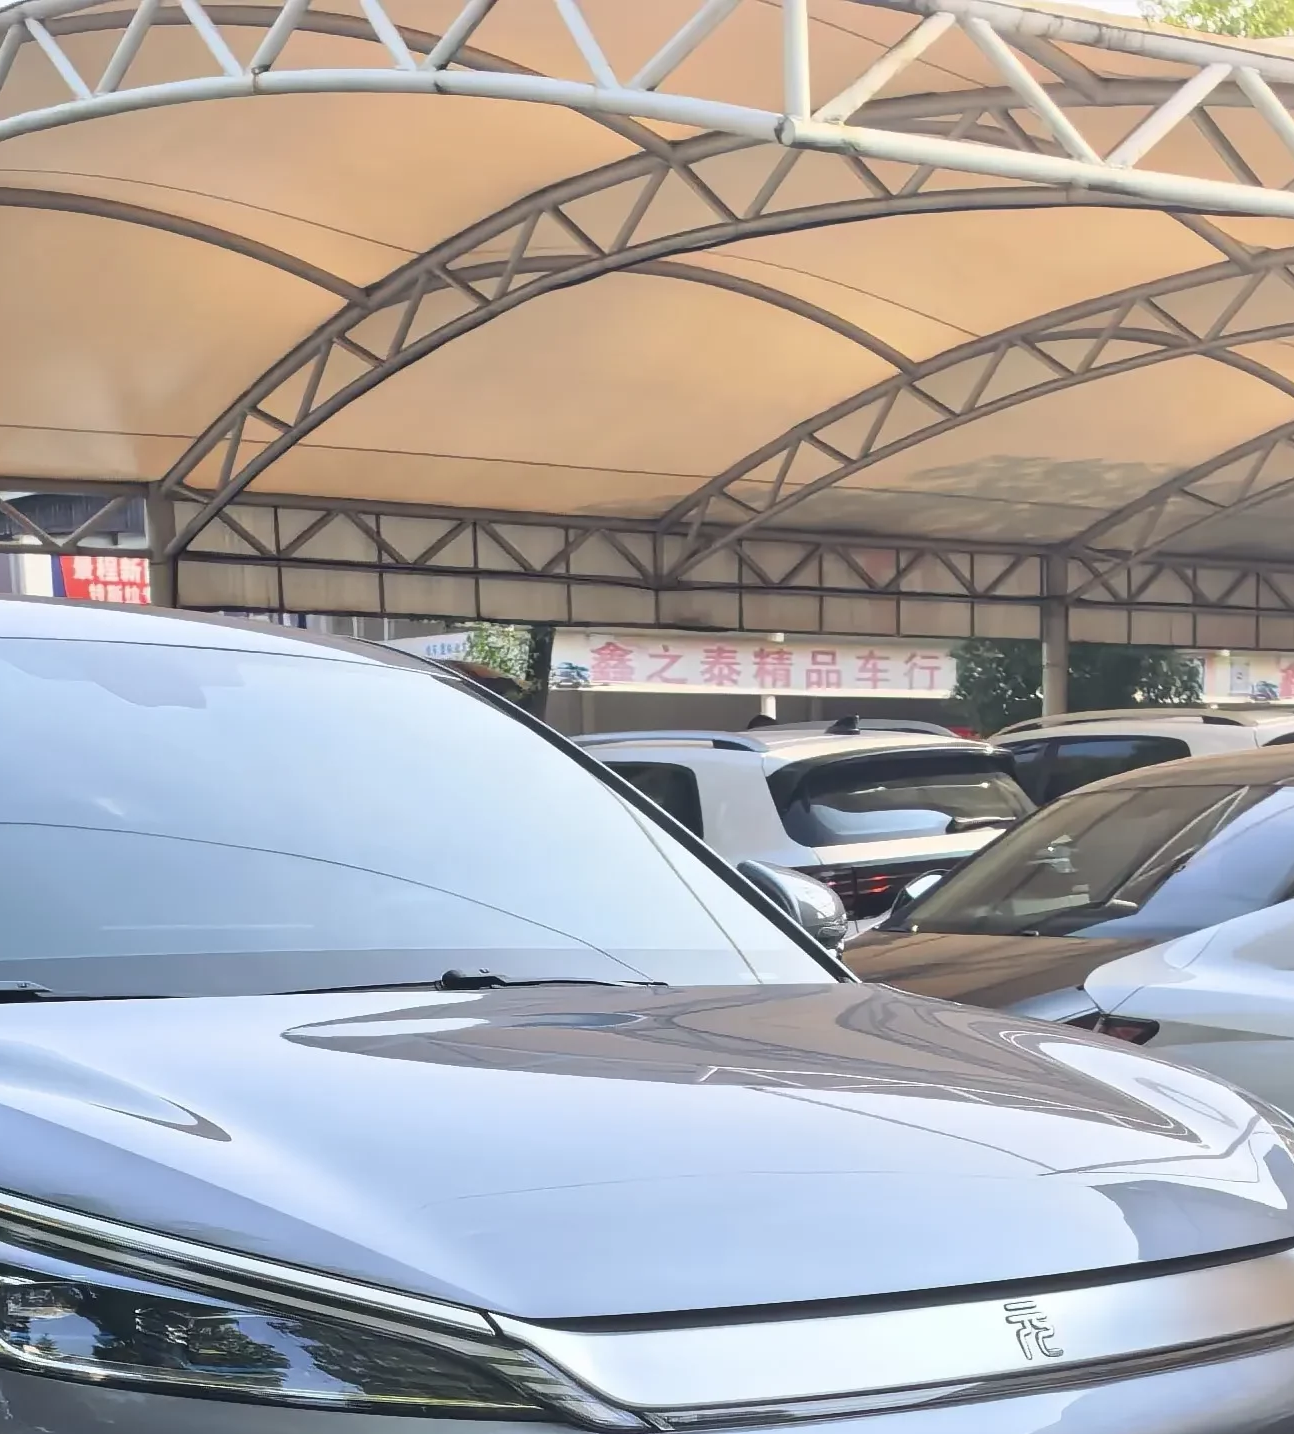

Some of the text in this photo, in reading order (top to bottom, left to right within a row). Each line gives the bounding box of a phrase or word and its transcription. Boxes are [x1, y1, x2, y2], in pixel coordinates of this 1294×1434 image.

[589, 640, 942, 690] 鑫之泰精品车行
